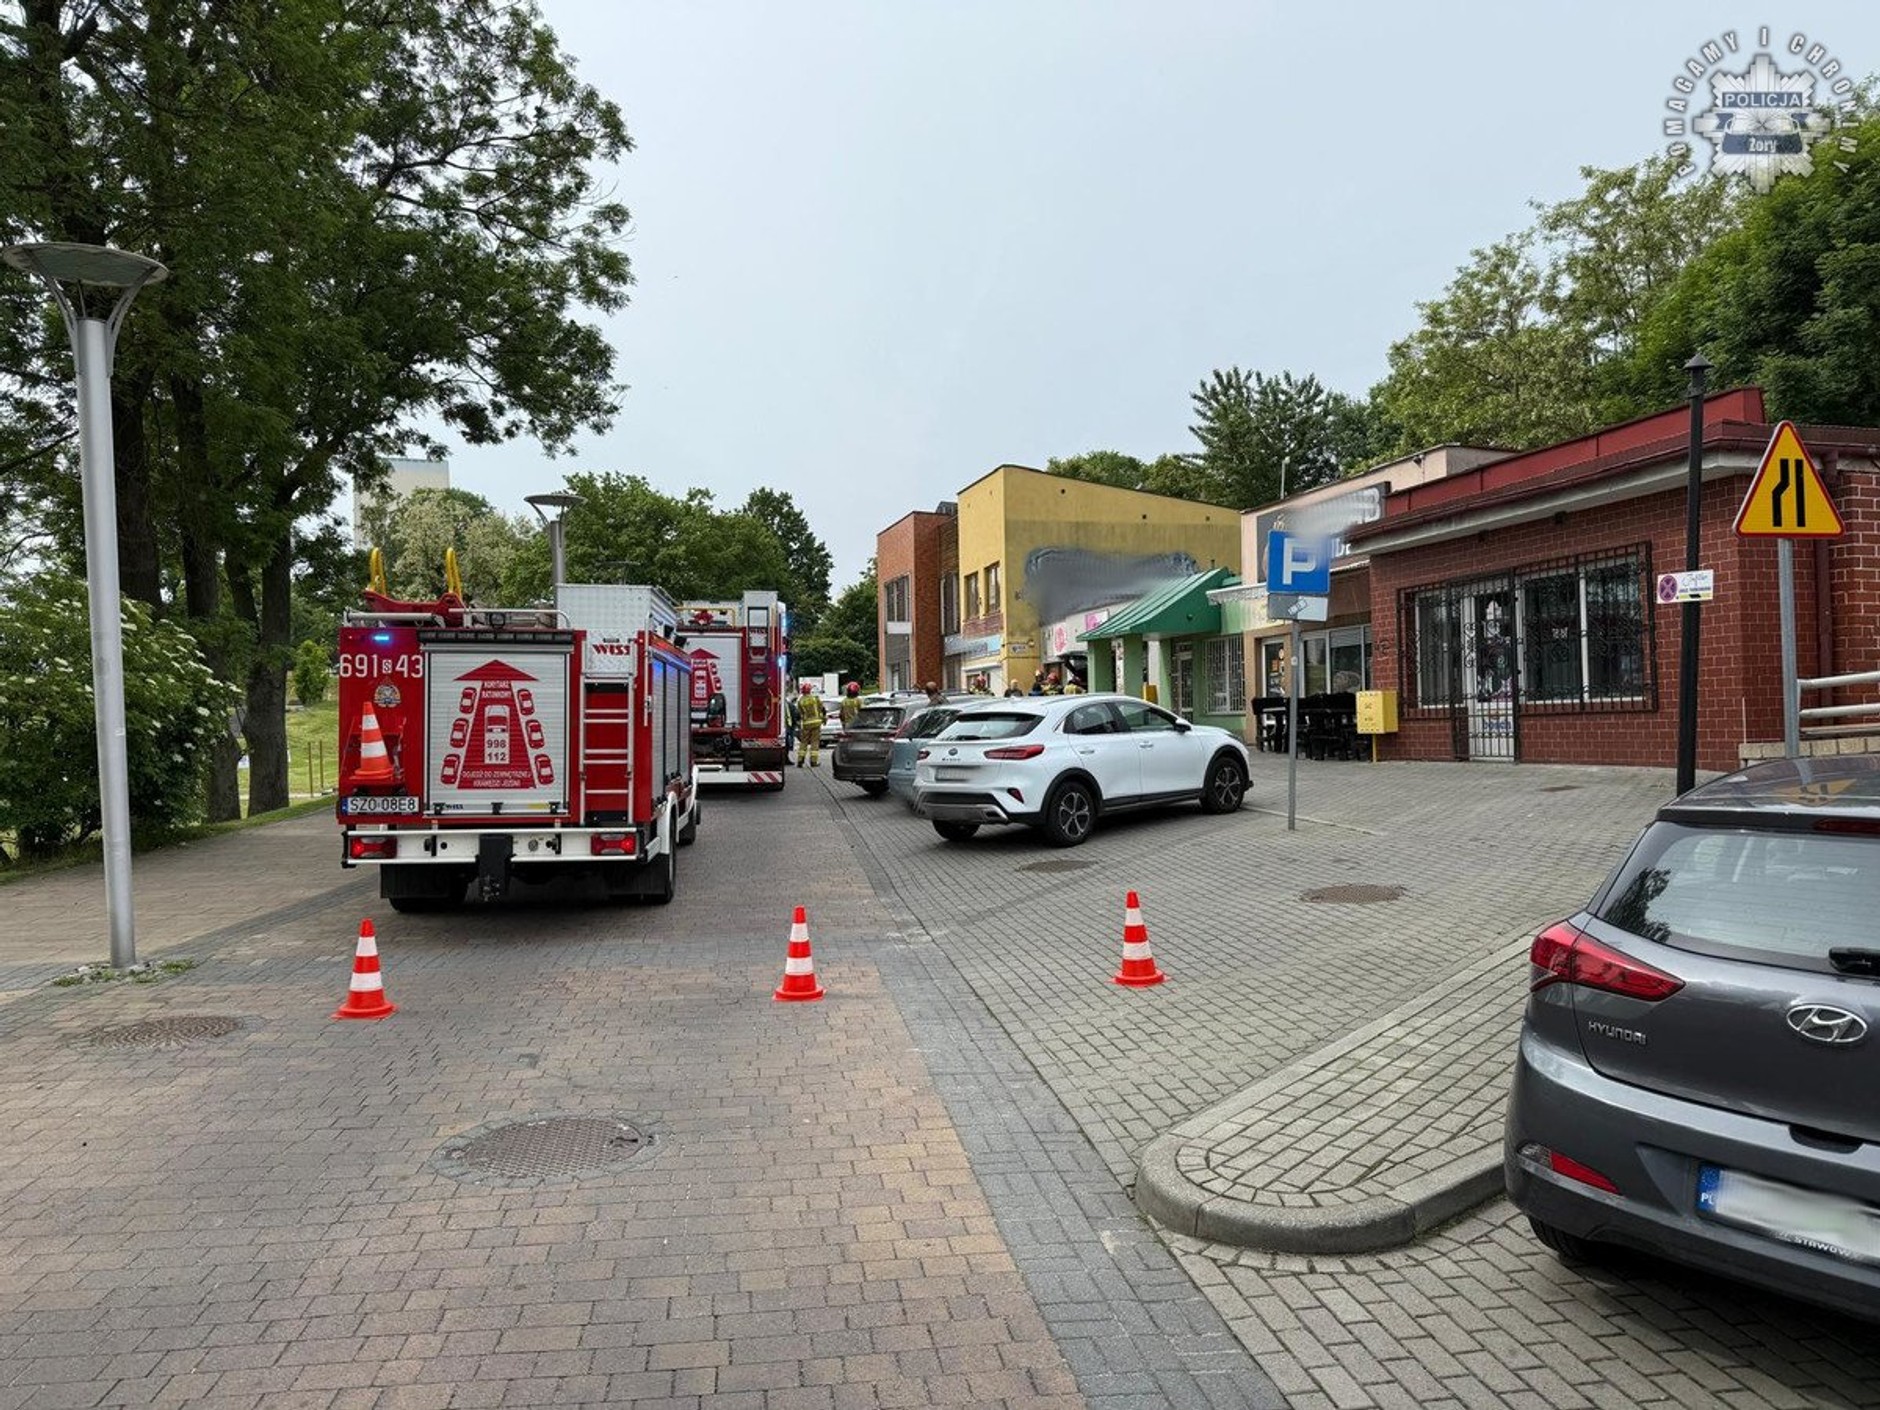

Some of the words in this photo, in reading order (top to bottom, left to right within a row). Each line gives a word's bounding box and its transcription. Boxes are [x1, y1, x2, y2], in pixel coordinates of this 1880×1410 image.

[1282, 537, 1317, 585] P
[592, 644, 630, 656] WISS
[486, 739, 507, 748] 998
[487, 752, 507, 761] 112
[1588, 1020, 1647, 1045] HYUNDAI
[1701, 1192, 1714, 1205] PL
